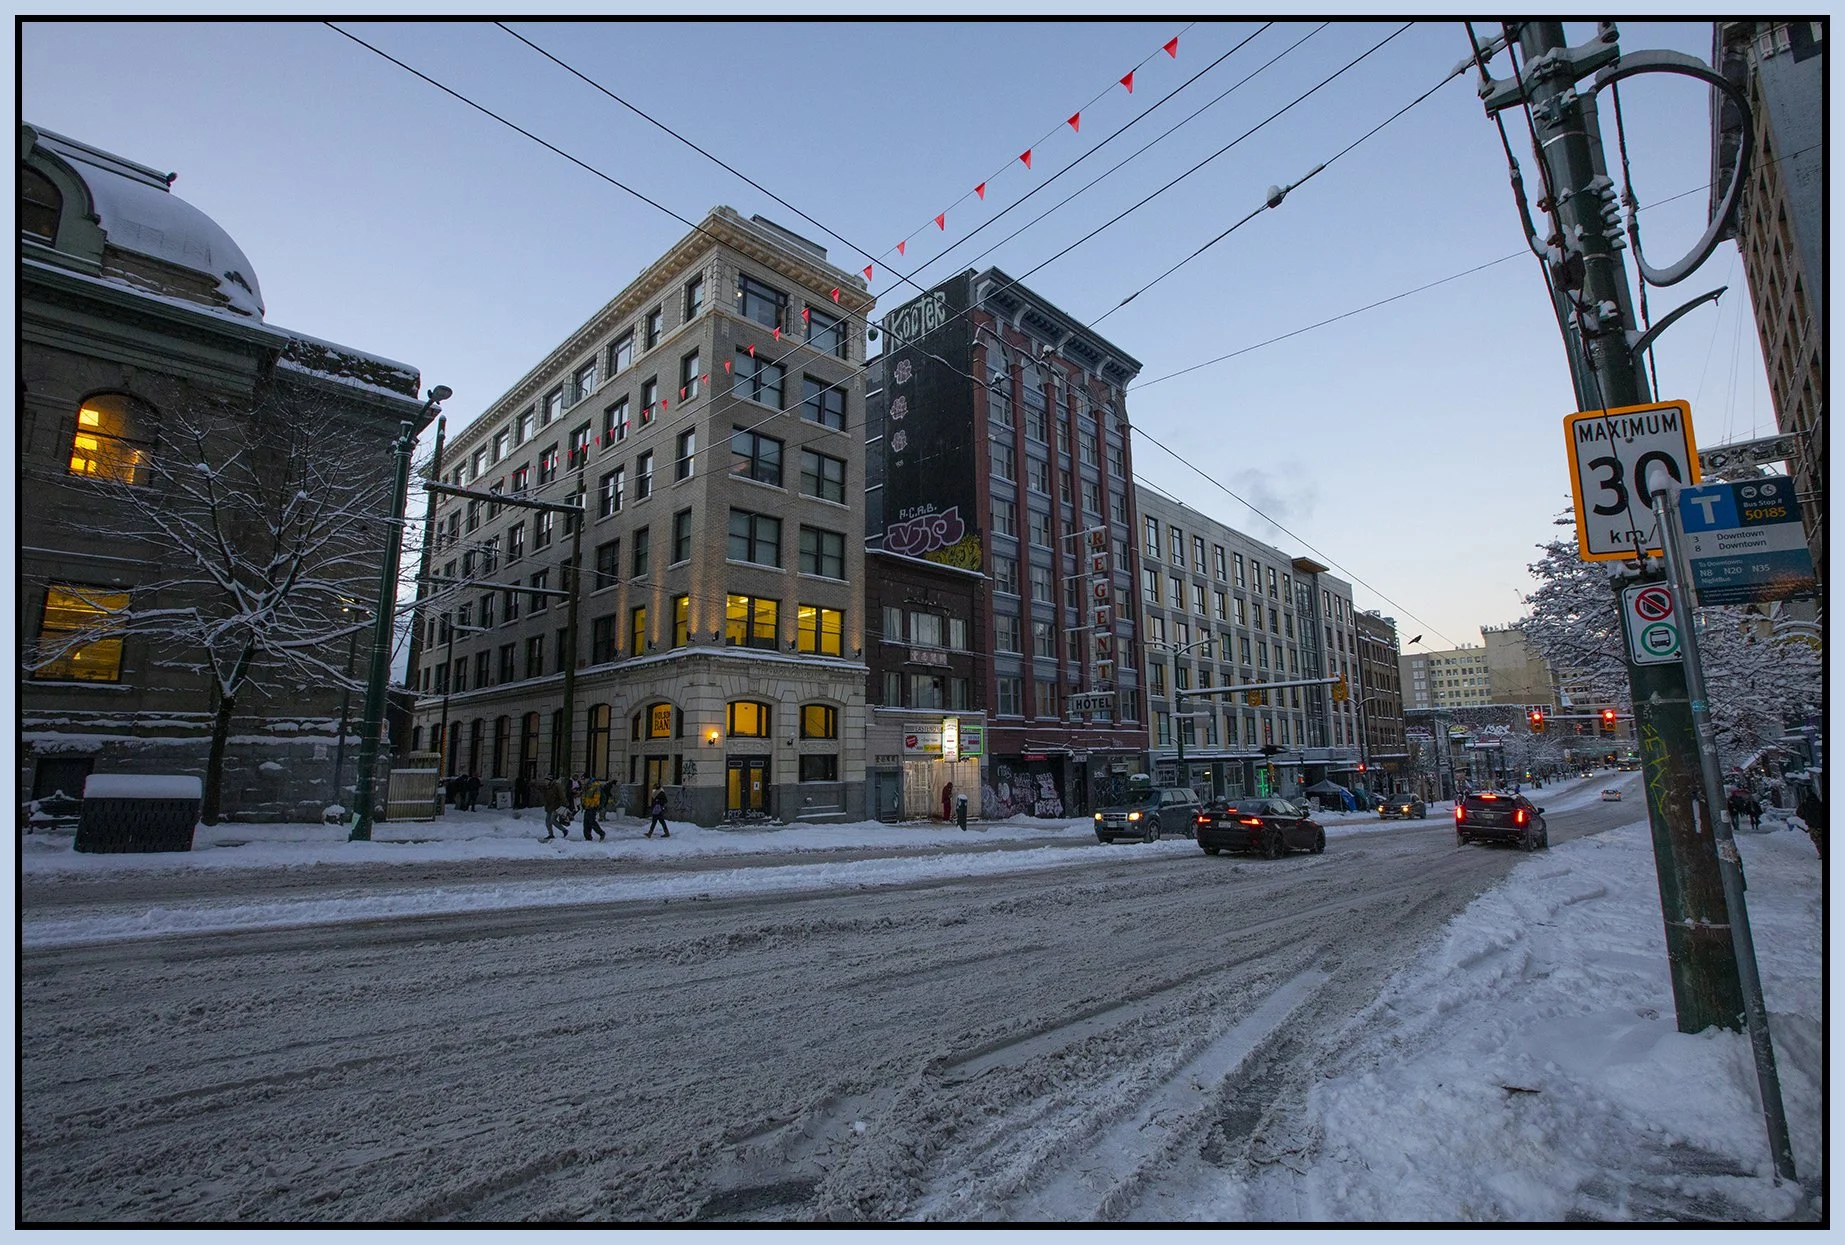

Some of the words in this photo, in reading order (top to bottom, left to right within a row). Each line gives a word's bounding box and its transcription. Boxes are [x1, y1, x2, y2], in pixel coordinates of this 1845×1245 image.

[1578, 413, 1678, 443] MAXIMUM
[1588, 450, 1682, 516] 30
[1690, 494, 1722, 525] T
[1759, 498, 1776, 507] Stop
[1745, 506, 1787, 520] 50185
[1693, 535, 1700, 543] 3
[1717, 529, 1765, 541] Downtown
[1718, 539, 1767, 550] Downtown
[1700, 569, 1713, 577] N8
[1724, 566, 1742, 575] N20
[1752, 563, 1770, 573] N35
[1091, 531, 1111, 681] REGENT
[1076, 697, 1112, 710] HOTEL
[654, 719, 671, 731] BAN
